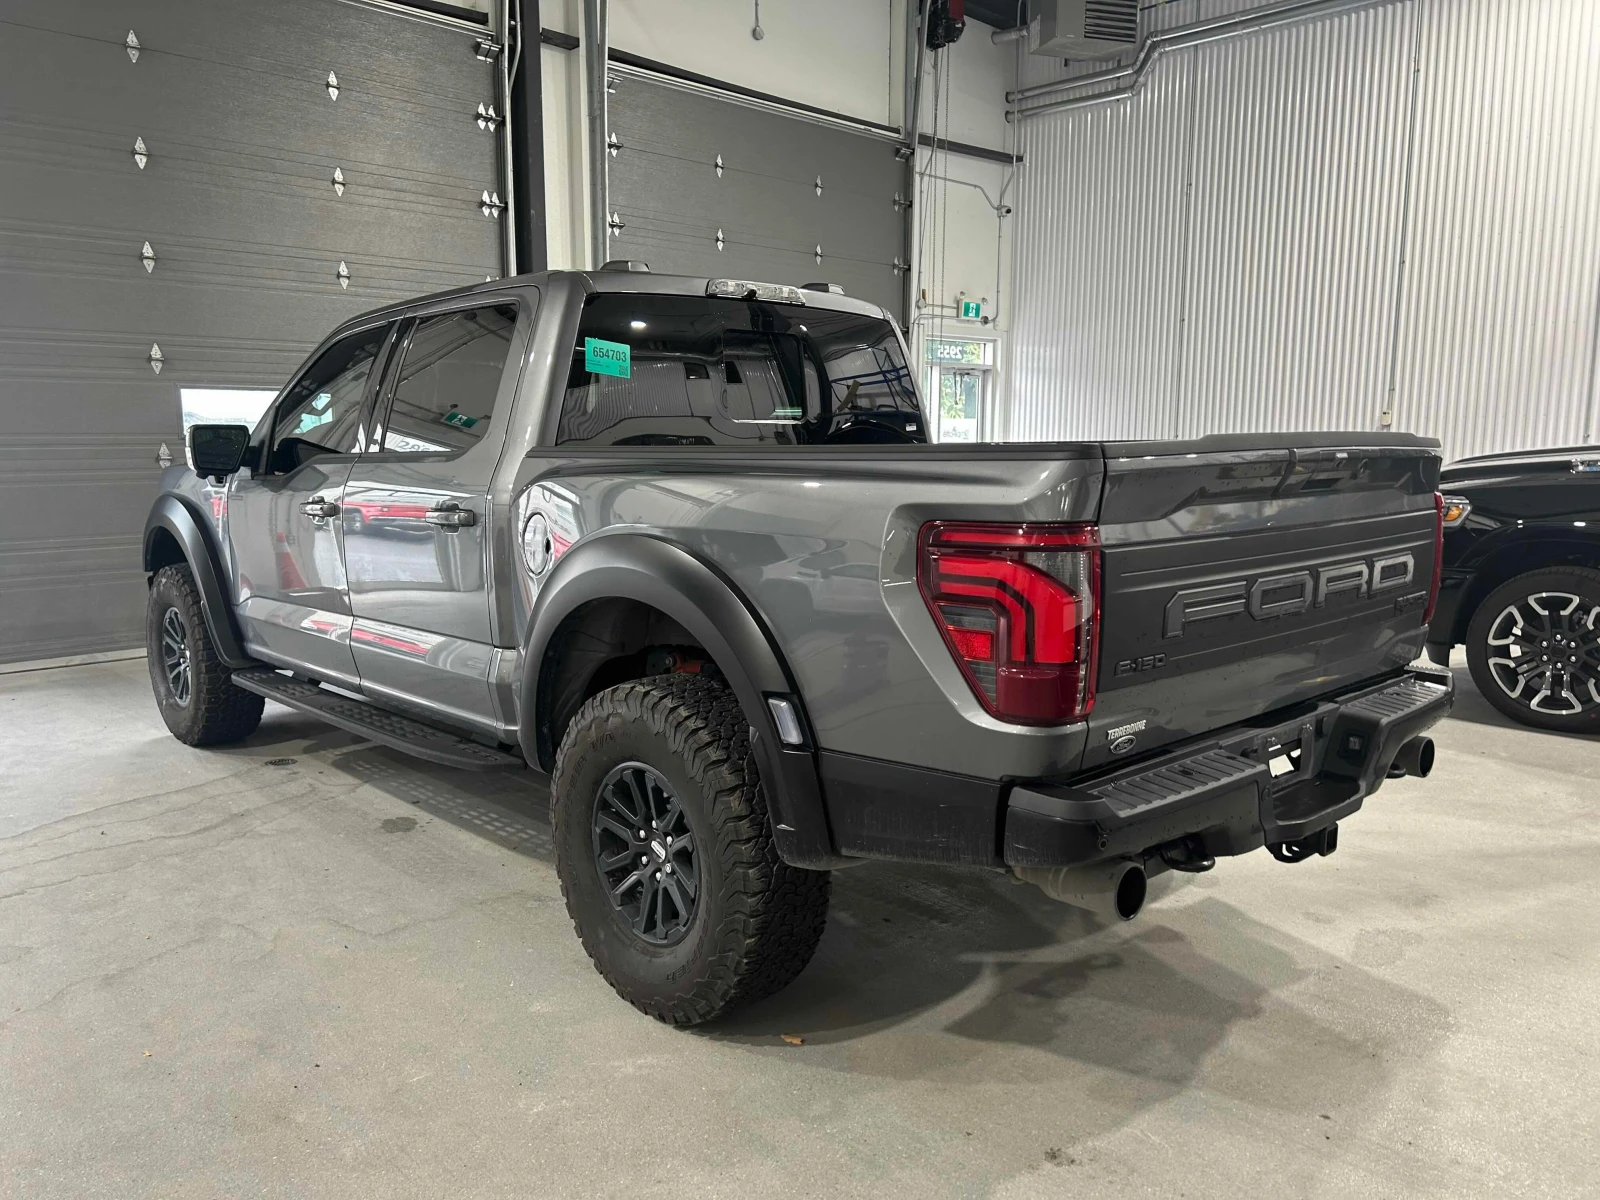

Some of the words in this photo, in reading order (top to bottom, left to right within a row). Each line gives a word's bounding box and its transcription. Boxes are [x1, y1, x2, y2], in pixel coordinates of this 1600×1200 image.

[592, 346, 627, 362] 654703
[1162, 551, 1415, 640] FORD
[1114, 652, 1167, 676] F-150
[1107, 719, 1147, 740] TERREBONNE
